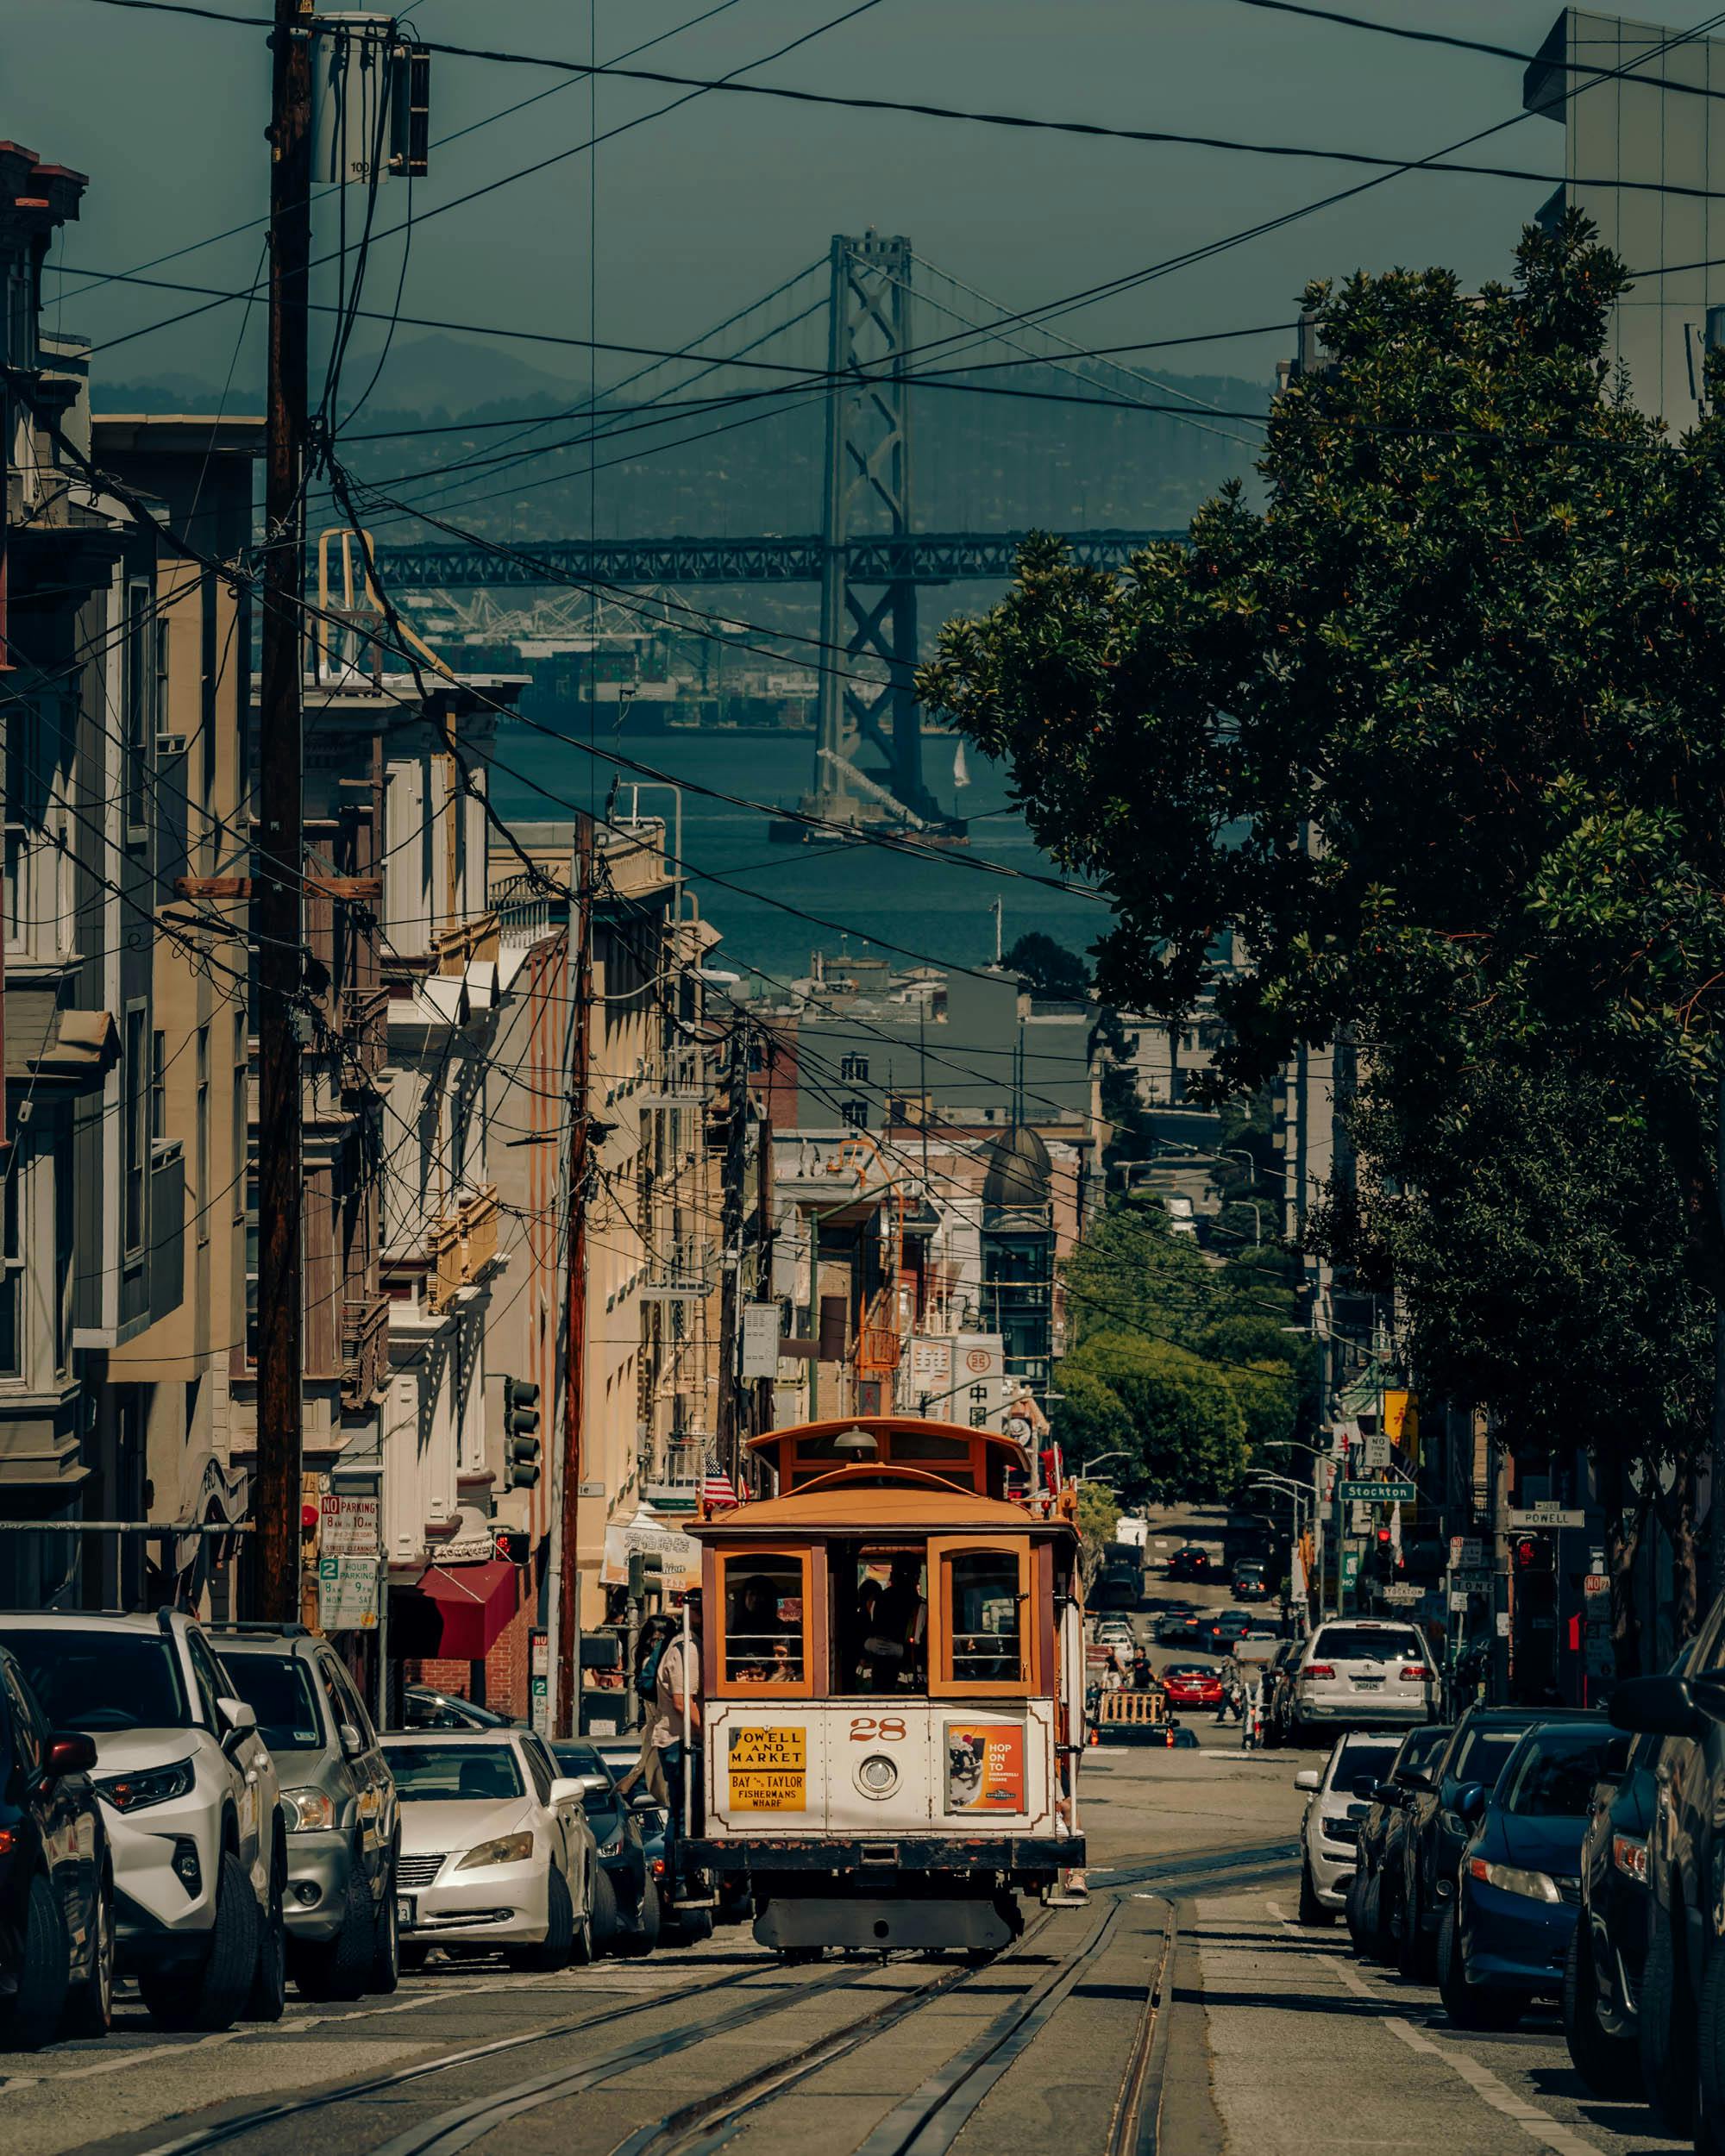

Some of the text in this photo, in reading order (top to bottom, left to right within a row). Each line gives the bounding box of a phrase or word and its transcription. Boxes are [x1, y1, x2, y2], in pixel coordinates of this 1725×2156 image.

[351, 162, 370, 173] 100
[1347, 1486, 1408, 1497] Stockton
[323, 1497, 375, 1514] NO PARKING
[1525, 1514, 1570, 1524] POWELL
[323, 1562, 368, 1576] 2 HOUR
[1587, 1578, 1600, 1590] NO
[535, 1682, 546, 1695] 2
[850, 1717, 907, 1742] 28
[735, 1733, 801, 1743] POWELL
[751, 1744, 784, 1752] AND
[988, 1743, 1013, 1752] HOP
[731, 1752, 802, 1762] MARKET
[988, 1753, 1006, 1763] ON
[988, 1763, 1004, 1771] TO
[732, 1776, 750, 1788] BAY
[767, 1776, 803, 1788] TAYLOR
[738, 1789, 797, 1799] FISHERMANS
[752, 1799, 782, 1808] WHARF
